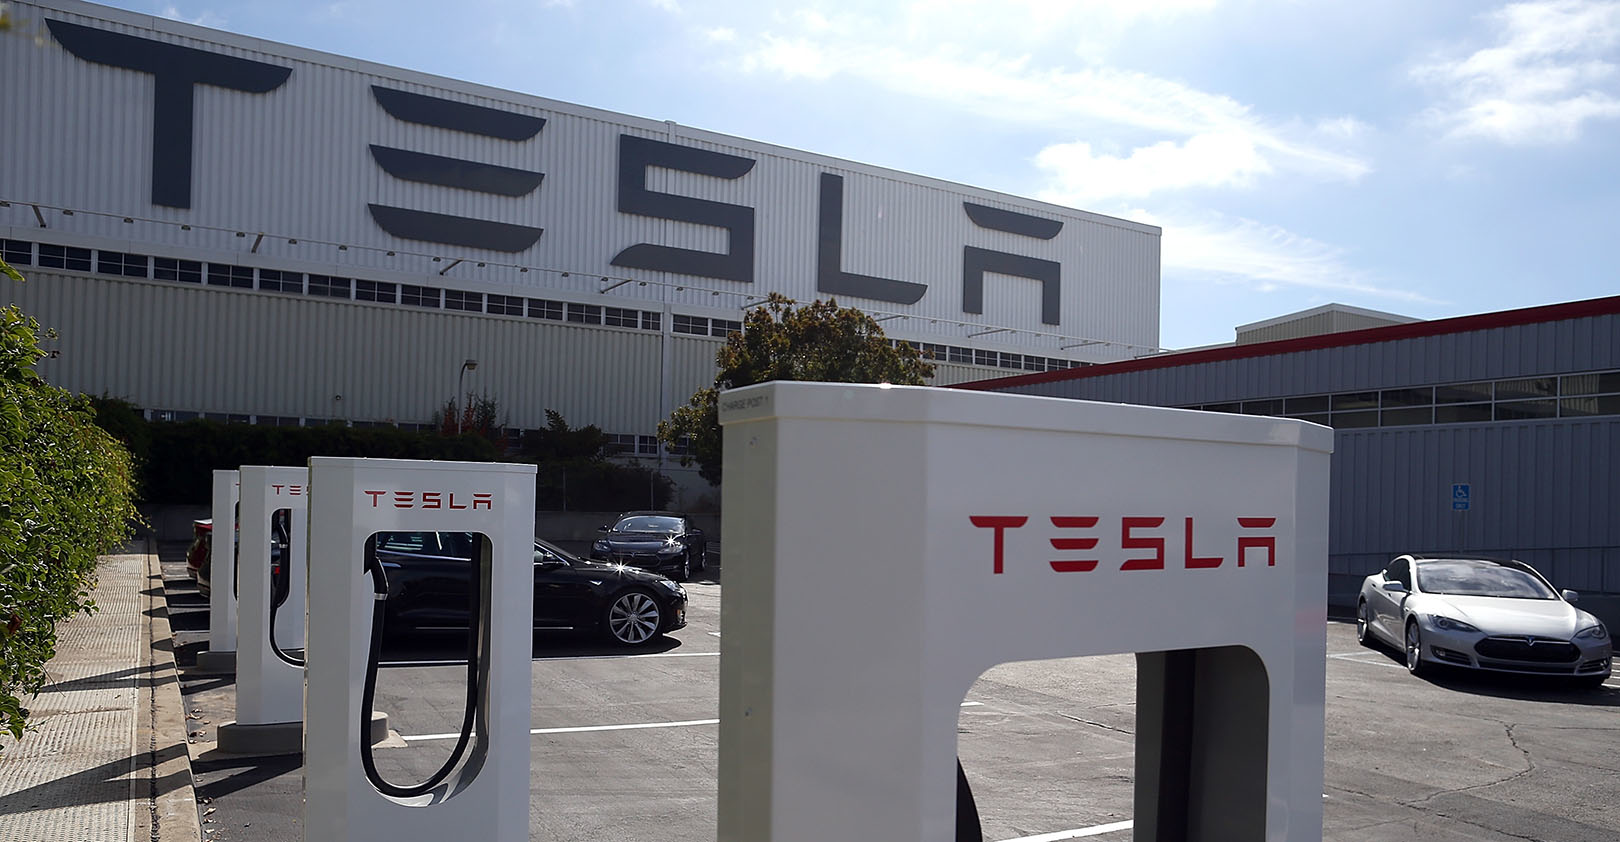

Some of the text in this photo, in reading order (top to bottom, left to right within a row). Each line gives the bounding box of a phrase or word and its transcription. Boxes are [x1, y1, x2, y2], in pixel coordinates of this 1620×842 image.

[45, 18, 1063, 326] TESLA
[272, 485, 308, 495] TE
[365, 490, 492, 510] TESLA
[969, 515, 1276, 574] TESLA
